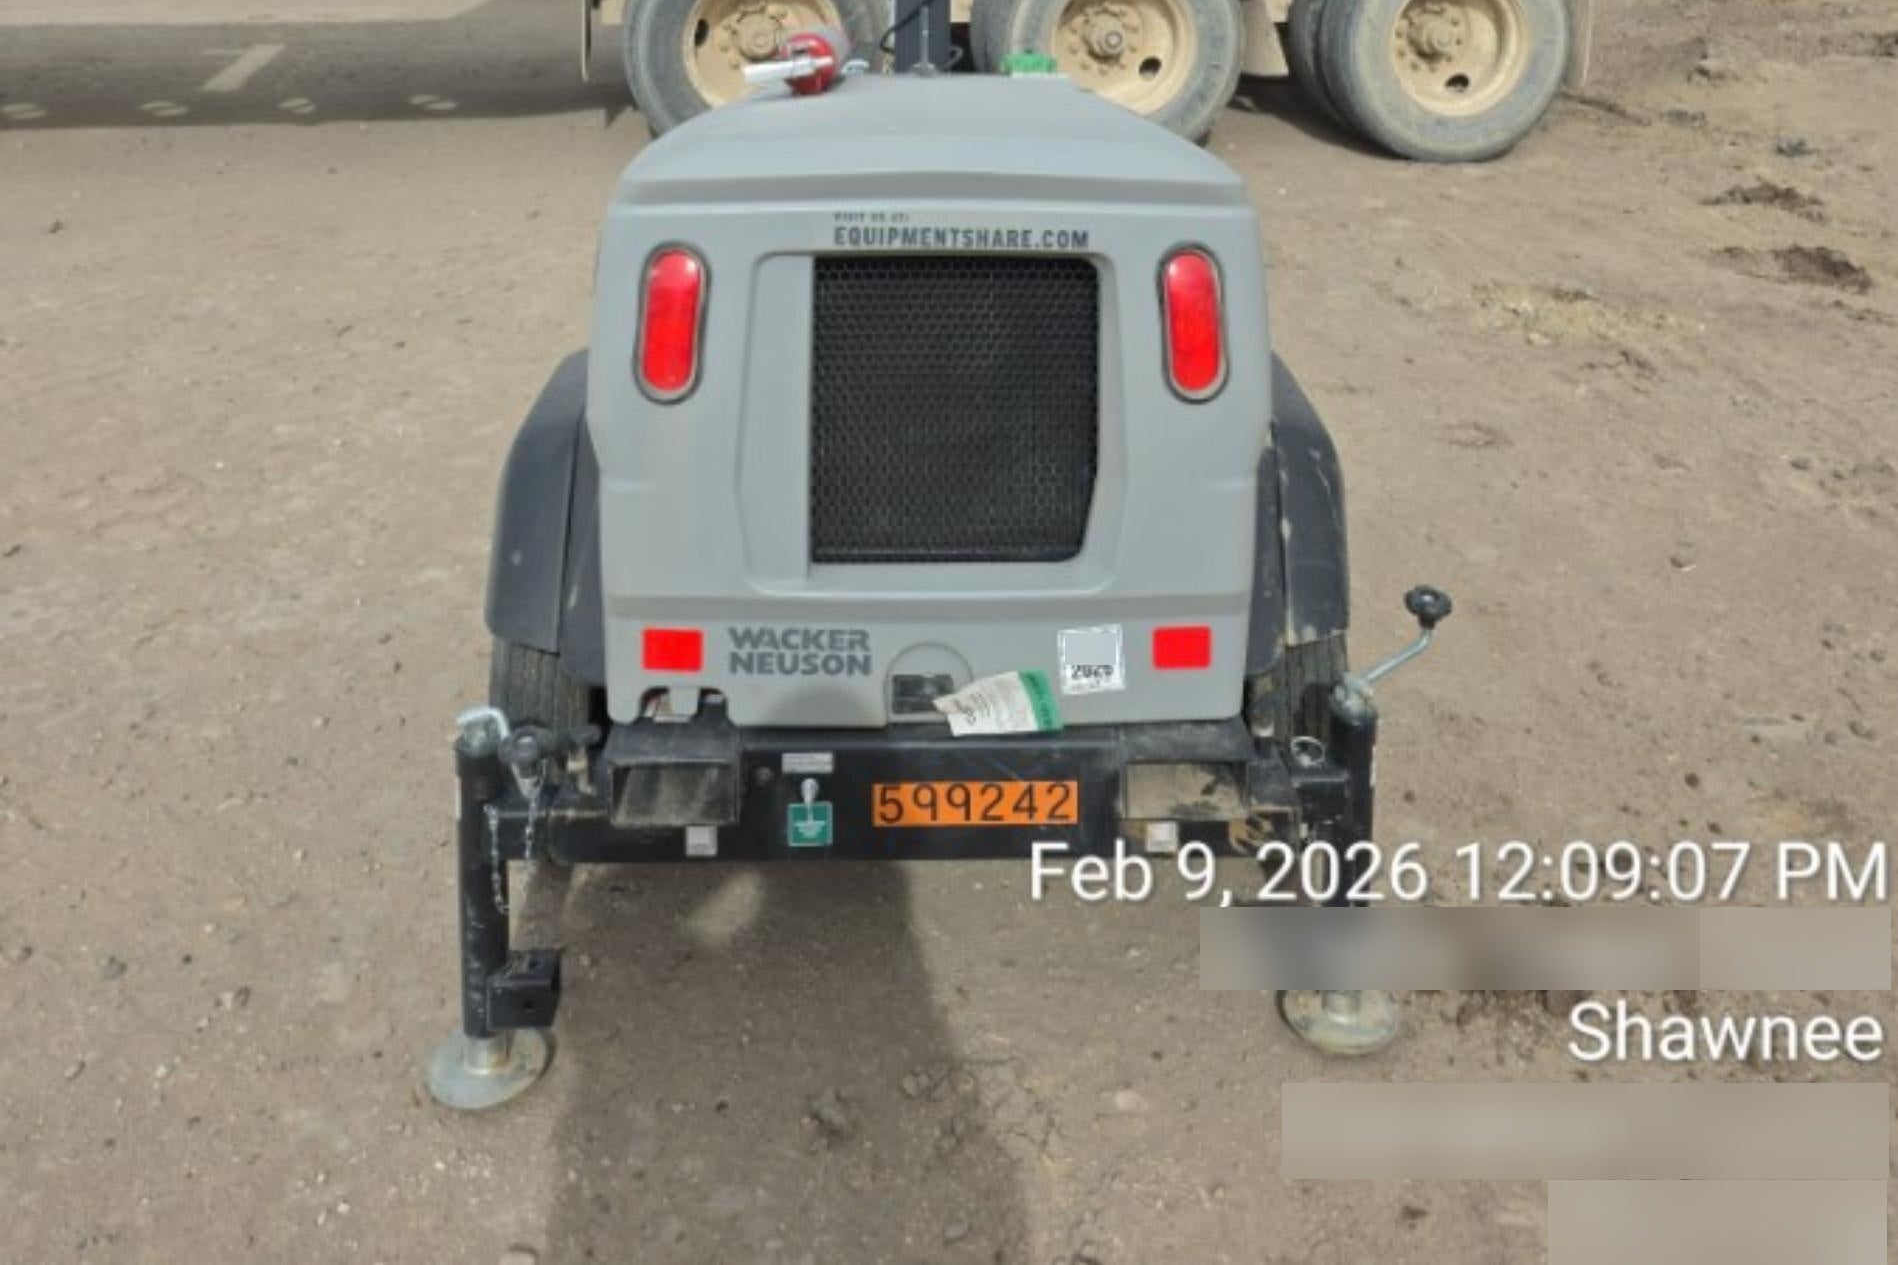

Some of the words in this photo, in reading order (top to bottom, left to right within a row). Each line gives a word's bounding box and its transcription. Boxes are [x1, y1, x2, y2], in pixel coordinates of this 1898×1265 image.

[834, 227, 1089, 248] EQUIPMENTSHARE.COM
[728, 627, 872, 652] WACKER
[729, 652, 872, 676] NEUSON
[879, 784, 1070, 824] 599242
